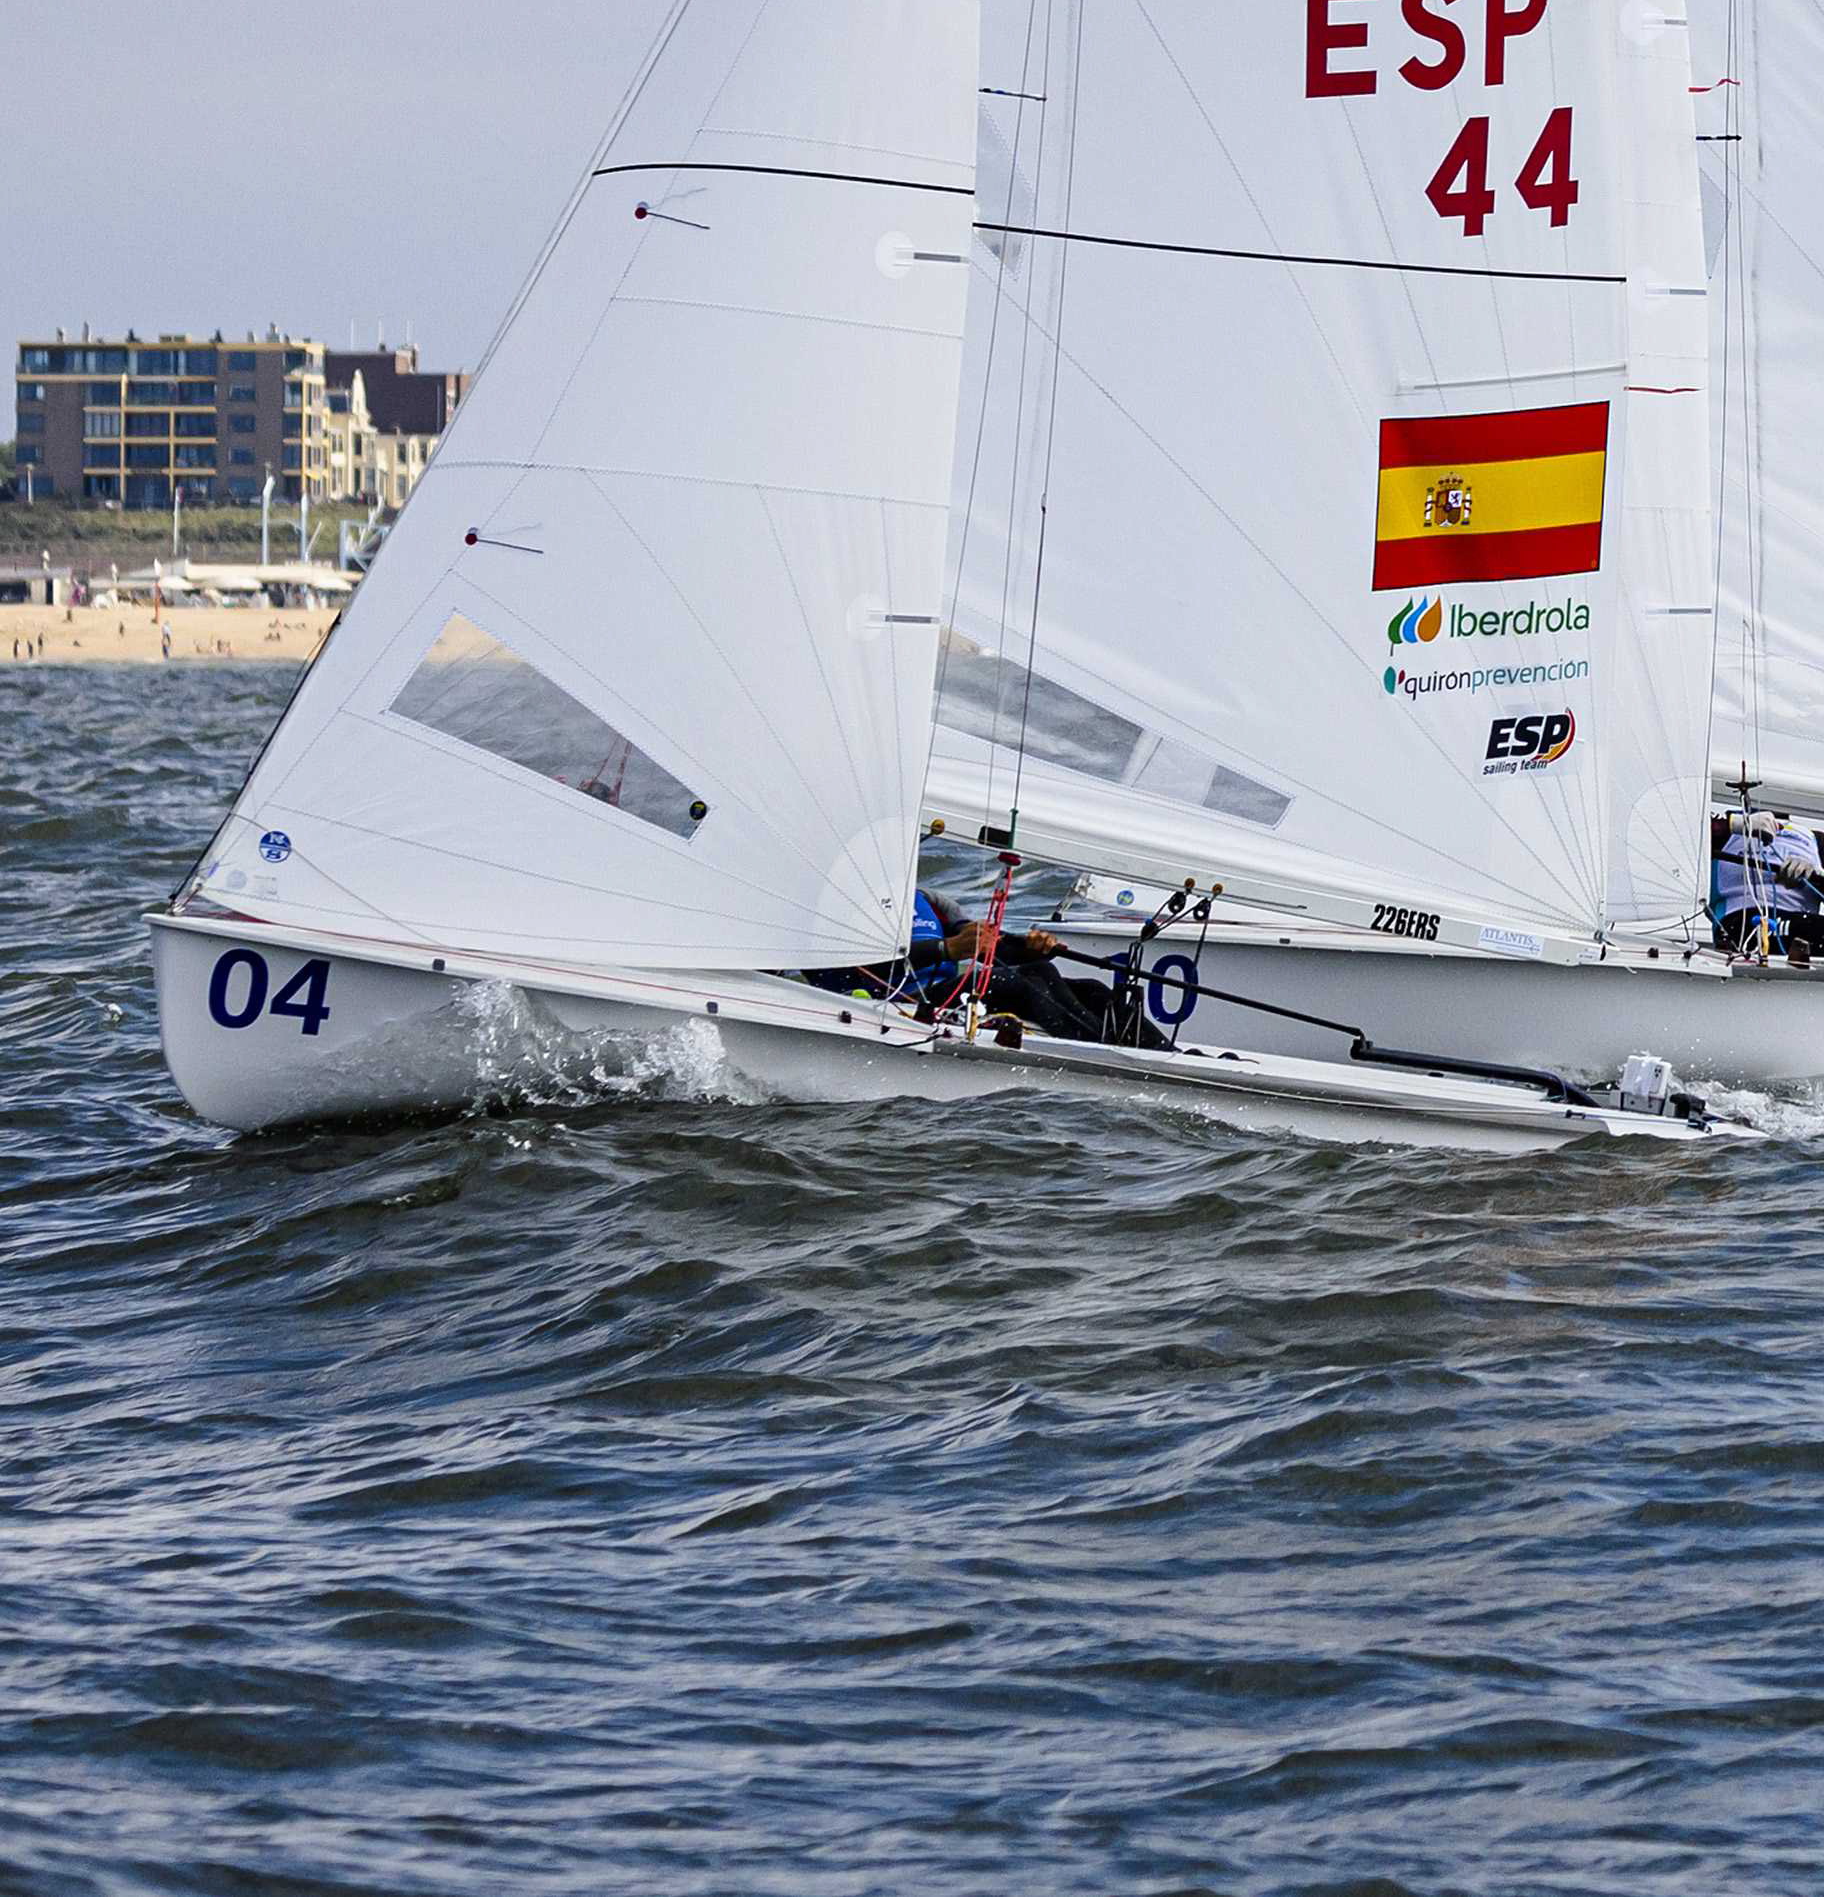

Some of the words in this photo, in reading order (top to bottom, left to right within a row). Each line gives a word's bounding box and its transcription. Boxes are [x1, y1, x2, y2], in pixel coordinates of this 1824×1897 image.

[1425, 106, 1579, 237] 44
[1450, 598, 1590, 639] Iberdrola
[1404, 657, 1589, 701] quirónprevención
[1485, 711, 1573, 761] ESP
[1483, 759, 1517, 776] sailing
[1521, 757, 1548, 771] team
[1370, 903, 1440, 941] 226ERS
[1482, 926, 1534, 946] ATLANTIS
[207, 948, 331, 1036] 04
